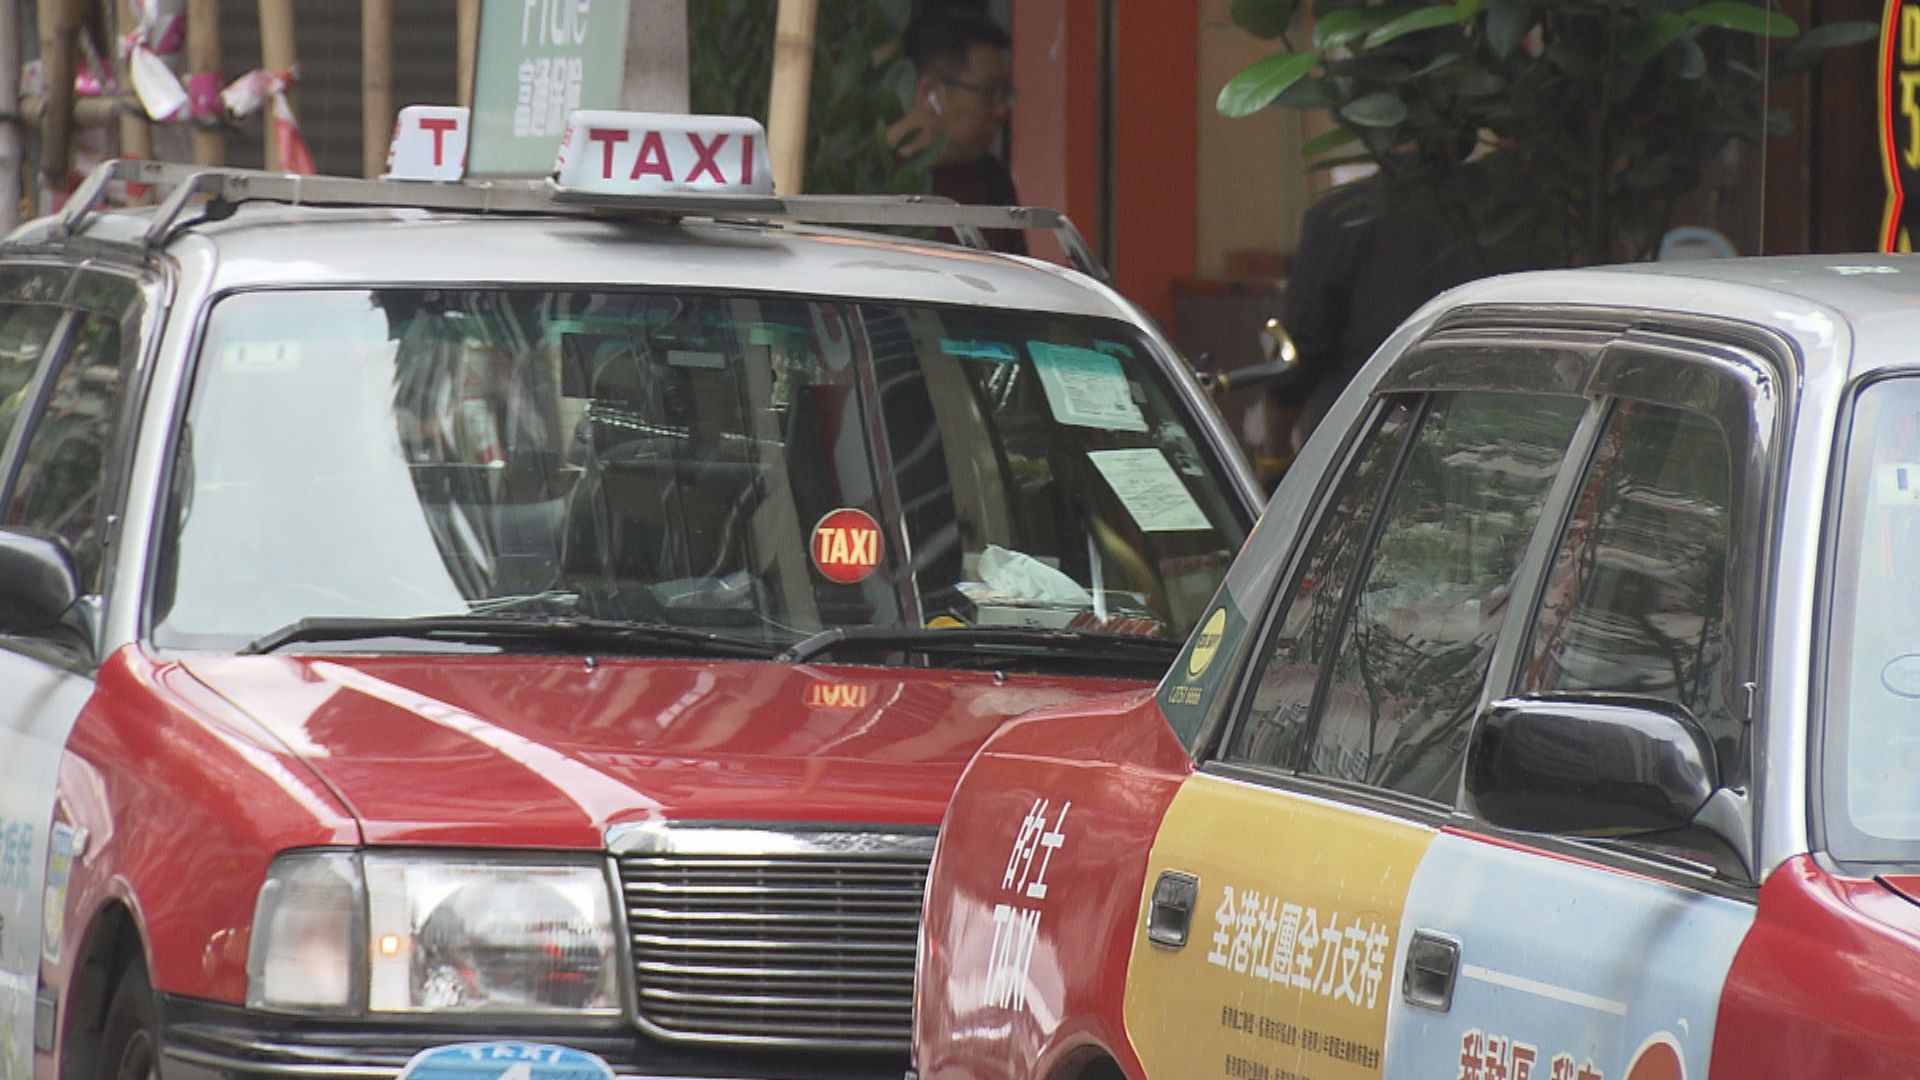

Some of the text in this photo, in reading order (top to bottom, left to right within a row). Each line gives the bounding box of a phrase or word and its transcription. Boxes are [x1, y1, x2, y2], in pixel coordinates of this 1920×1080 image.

[588, 127, 754, 186] TAXI
[816, 527, 879, 566] TAXI
[1001, 797, 1072, 899] 的士
[983, 903, 1042, 1012] TAXI
[1207, 885, 1390, 1010] 全港社團全力支持
[461, 1046, 562, 1066] TAXI
